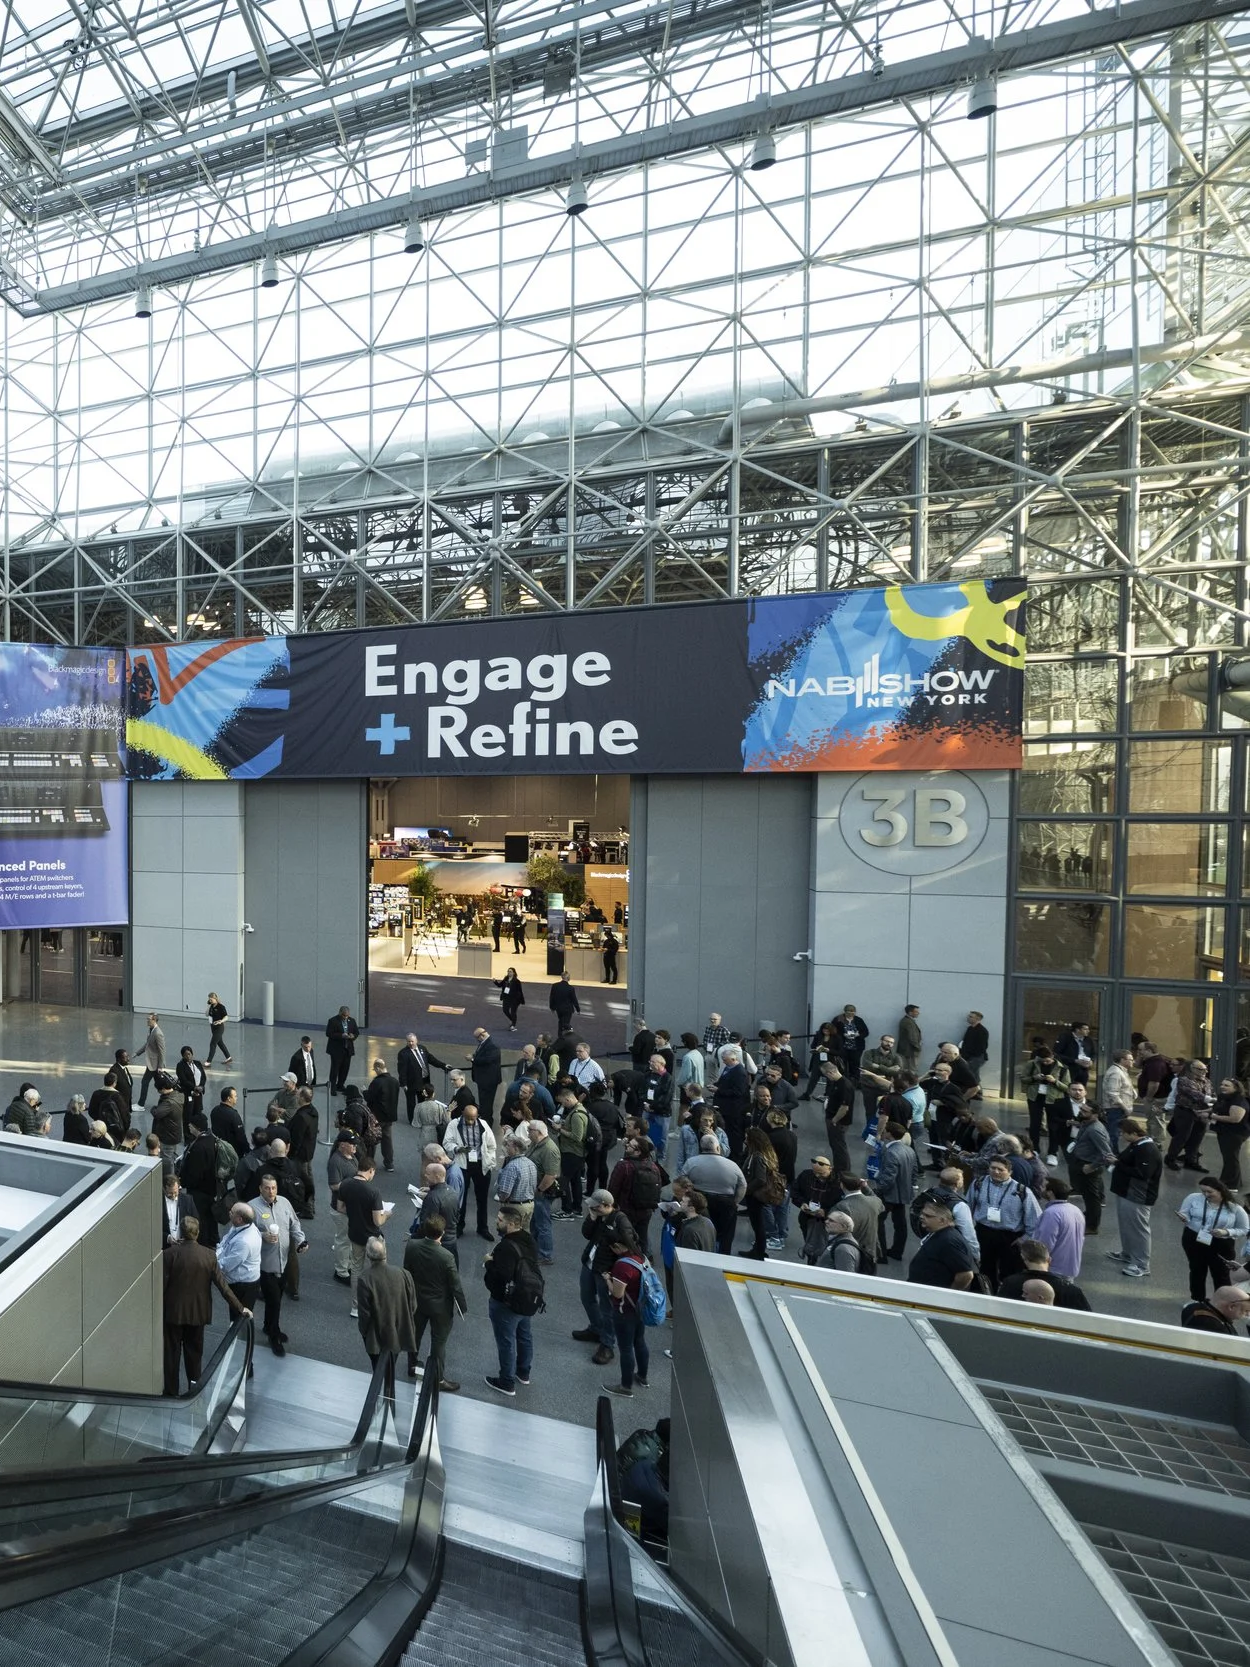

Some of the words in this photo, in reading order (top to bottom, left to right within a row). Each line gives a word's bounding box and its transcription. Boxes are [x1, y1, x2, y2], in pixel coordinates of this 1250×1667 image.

[364, 643, 612, 706] Engage
[878, 668, 995, 696] SHOW
[866, 696, 916, 709] NEW
[925, 692, 988, 707] YORK
[427, 701, 639, 758] Refine
[858, 788, 969, 848] 3B
[29, 859, 66, 872] Panels
[0, 876, 20, 885] panels
[20, 875, 29, 883] for
[29, 875, 47, 883] ATEM
[47, 874, 74, 883] switchers
[5, 884, 26, 892] control
[26, 884, 33, 892] of
[37, 883, 64, 892] upstream
[64, 882, 84, 892] keyers,
[4, 893, 19, 901] M/E
[35, 892, 47, 900] and
